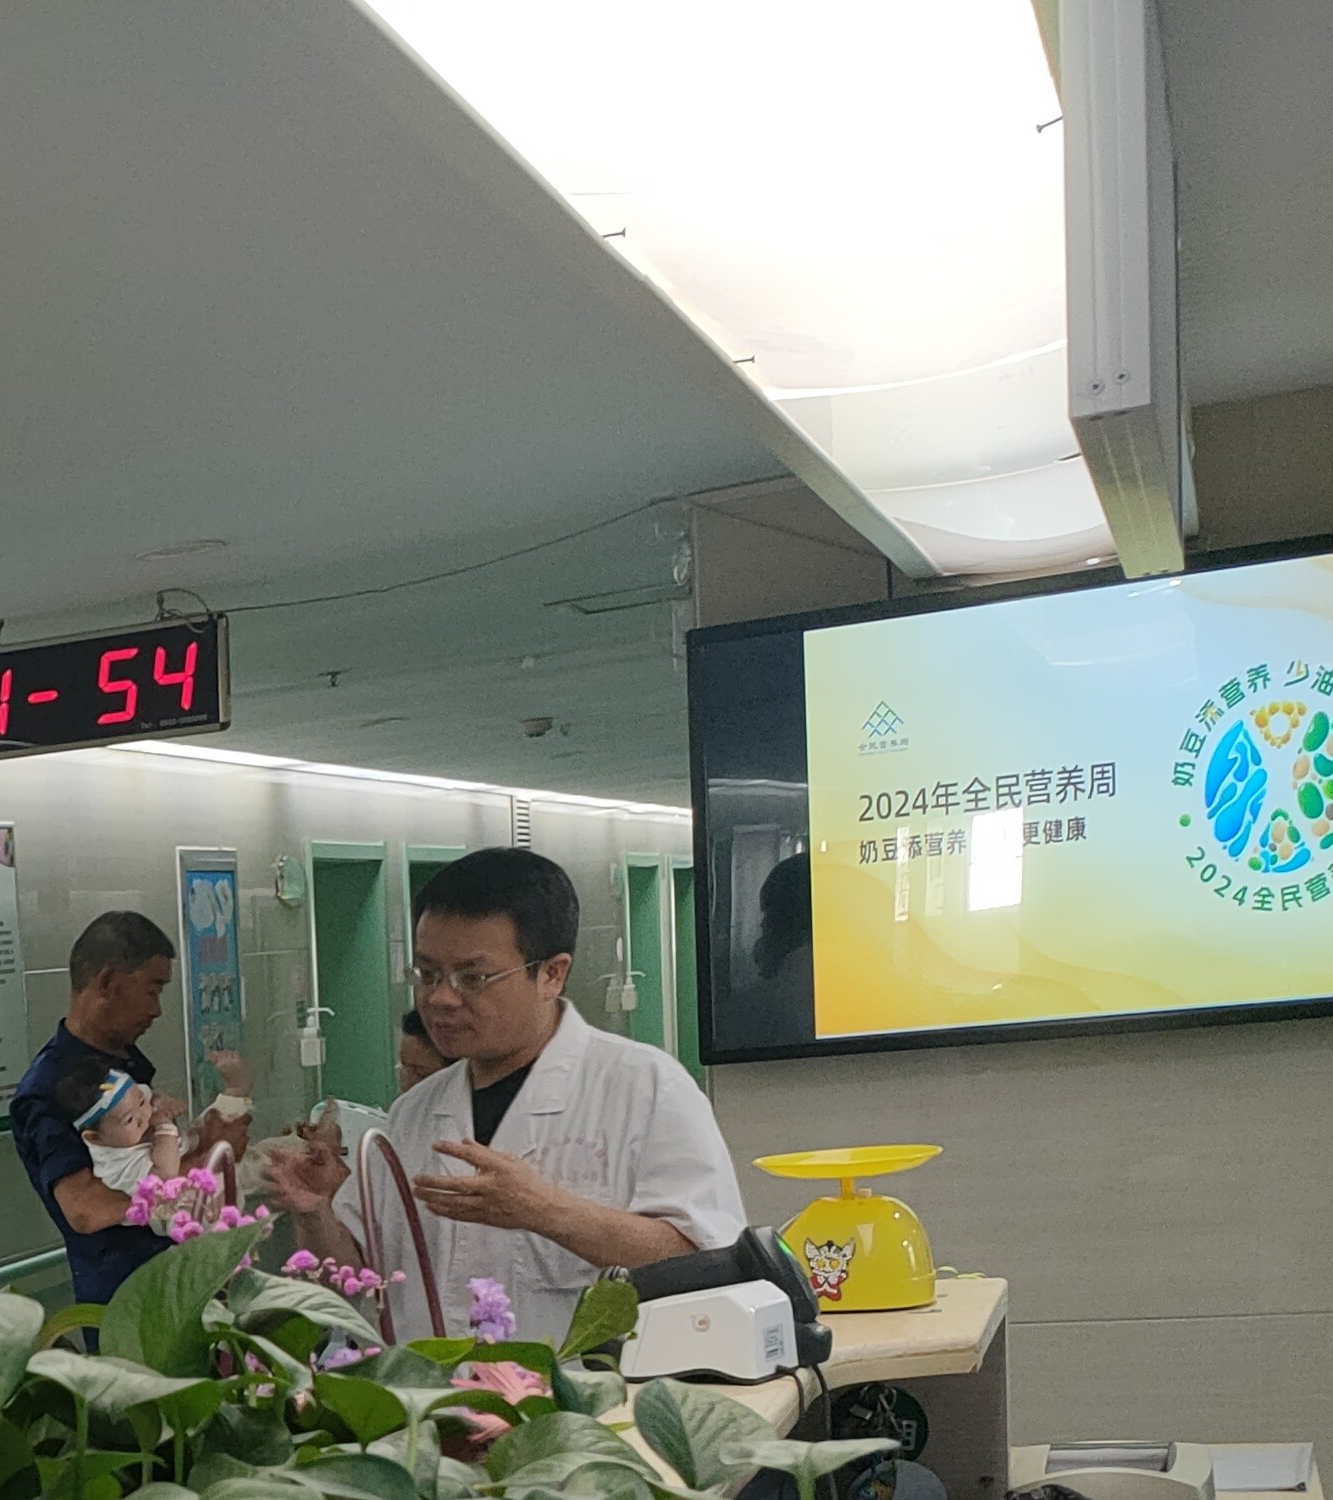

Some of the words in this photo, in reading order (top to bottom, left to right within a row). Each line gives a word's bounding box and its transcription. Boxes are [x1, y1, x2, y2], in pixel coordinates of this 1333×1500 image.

[1171, 662, 1272, 788] 奶豆添营养
[858, 760, 1117, 823] 2024年全民营养周
[1186, 846, 1333, 912] 2024全民营
